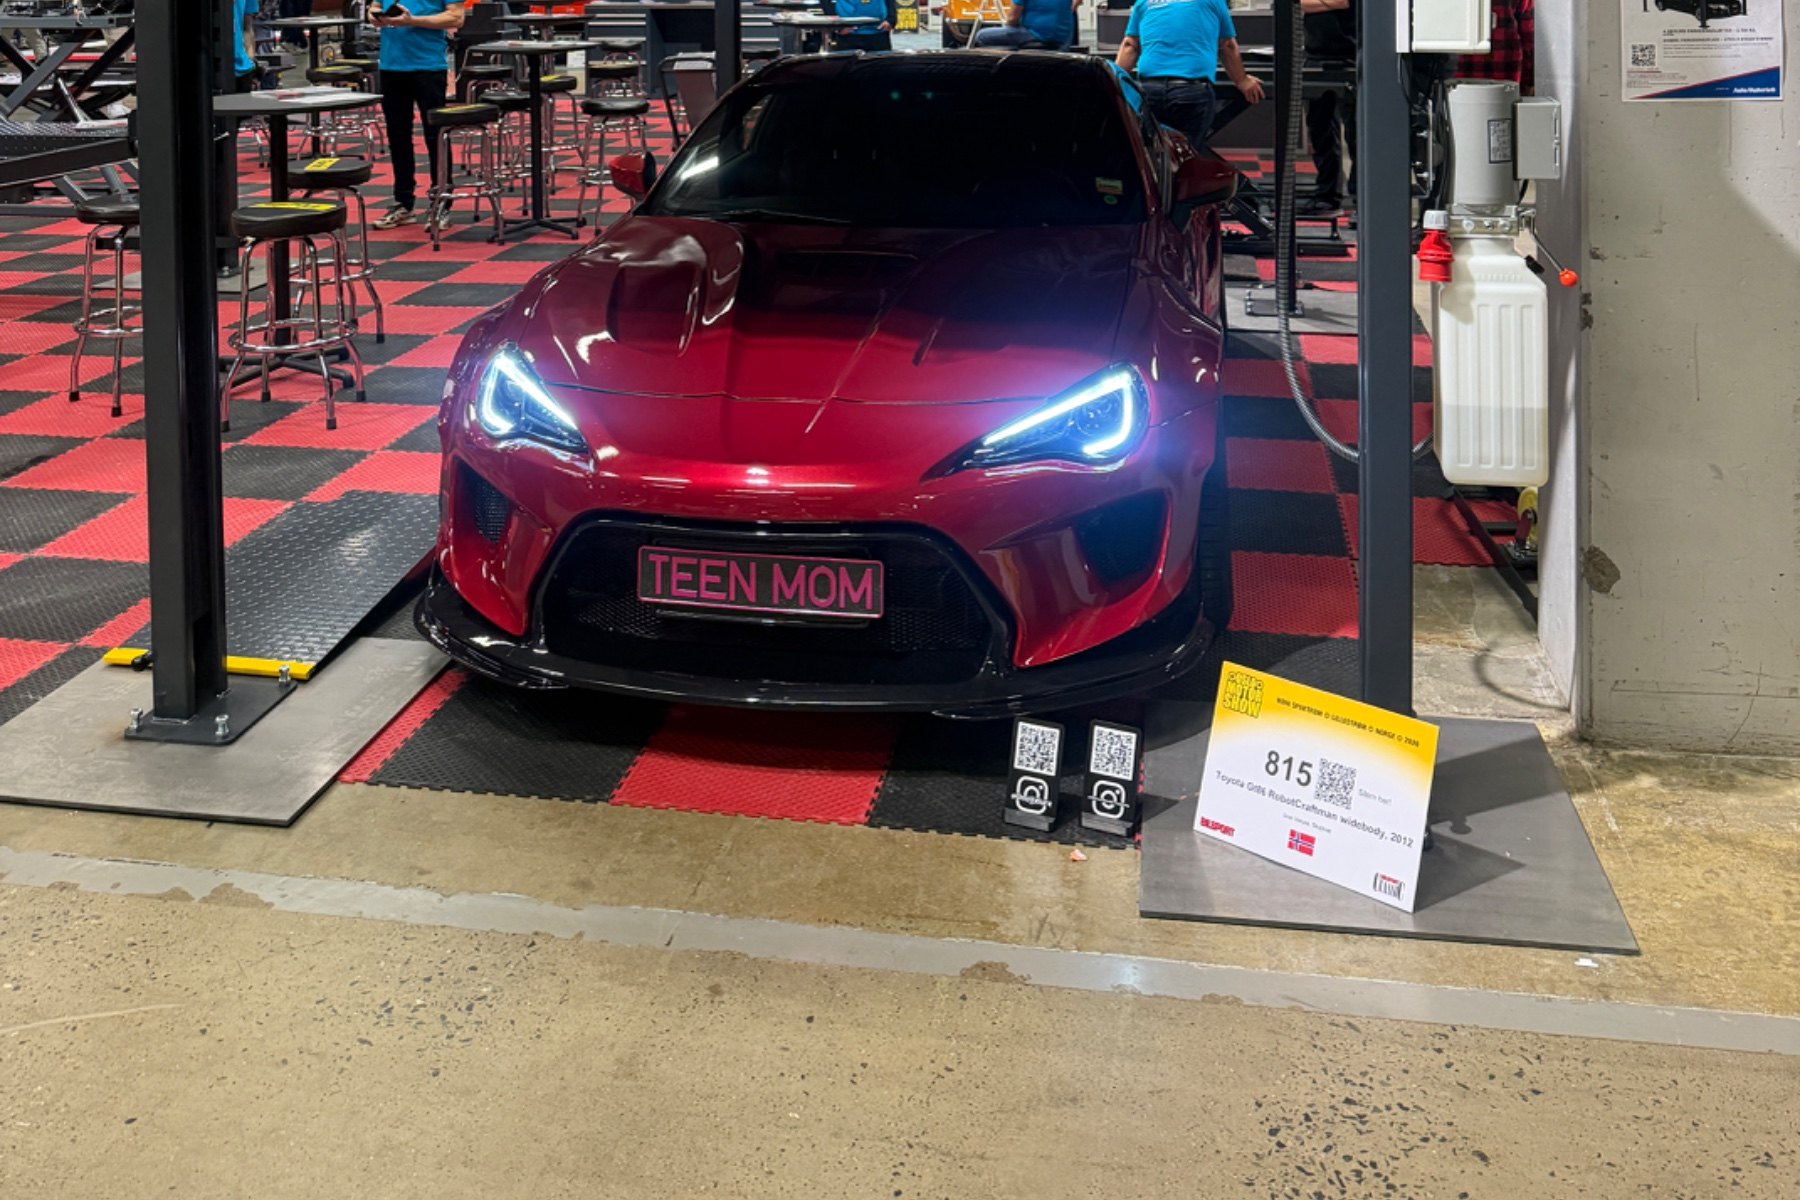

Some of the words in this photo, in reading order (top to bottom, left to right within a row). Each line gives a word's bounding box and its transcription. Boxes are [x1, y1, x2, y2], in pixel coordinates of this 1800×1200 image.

[648, 554, 756, 604] TEEN
[772, 563, 873, 610] MOM
[1223, 692, 1262, 719] SHOW
[1265, 750, 1313, 787] 815
[1216, 770, 1245, 789] Toyota
[1340, 815, 1388, 841] widebody,
[1390, 832, 1414, 848] 2012
